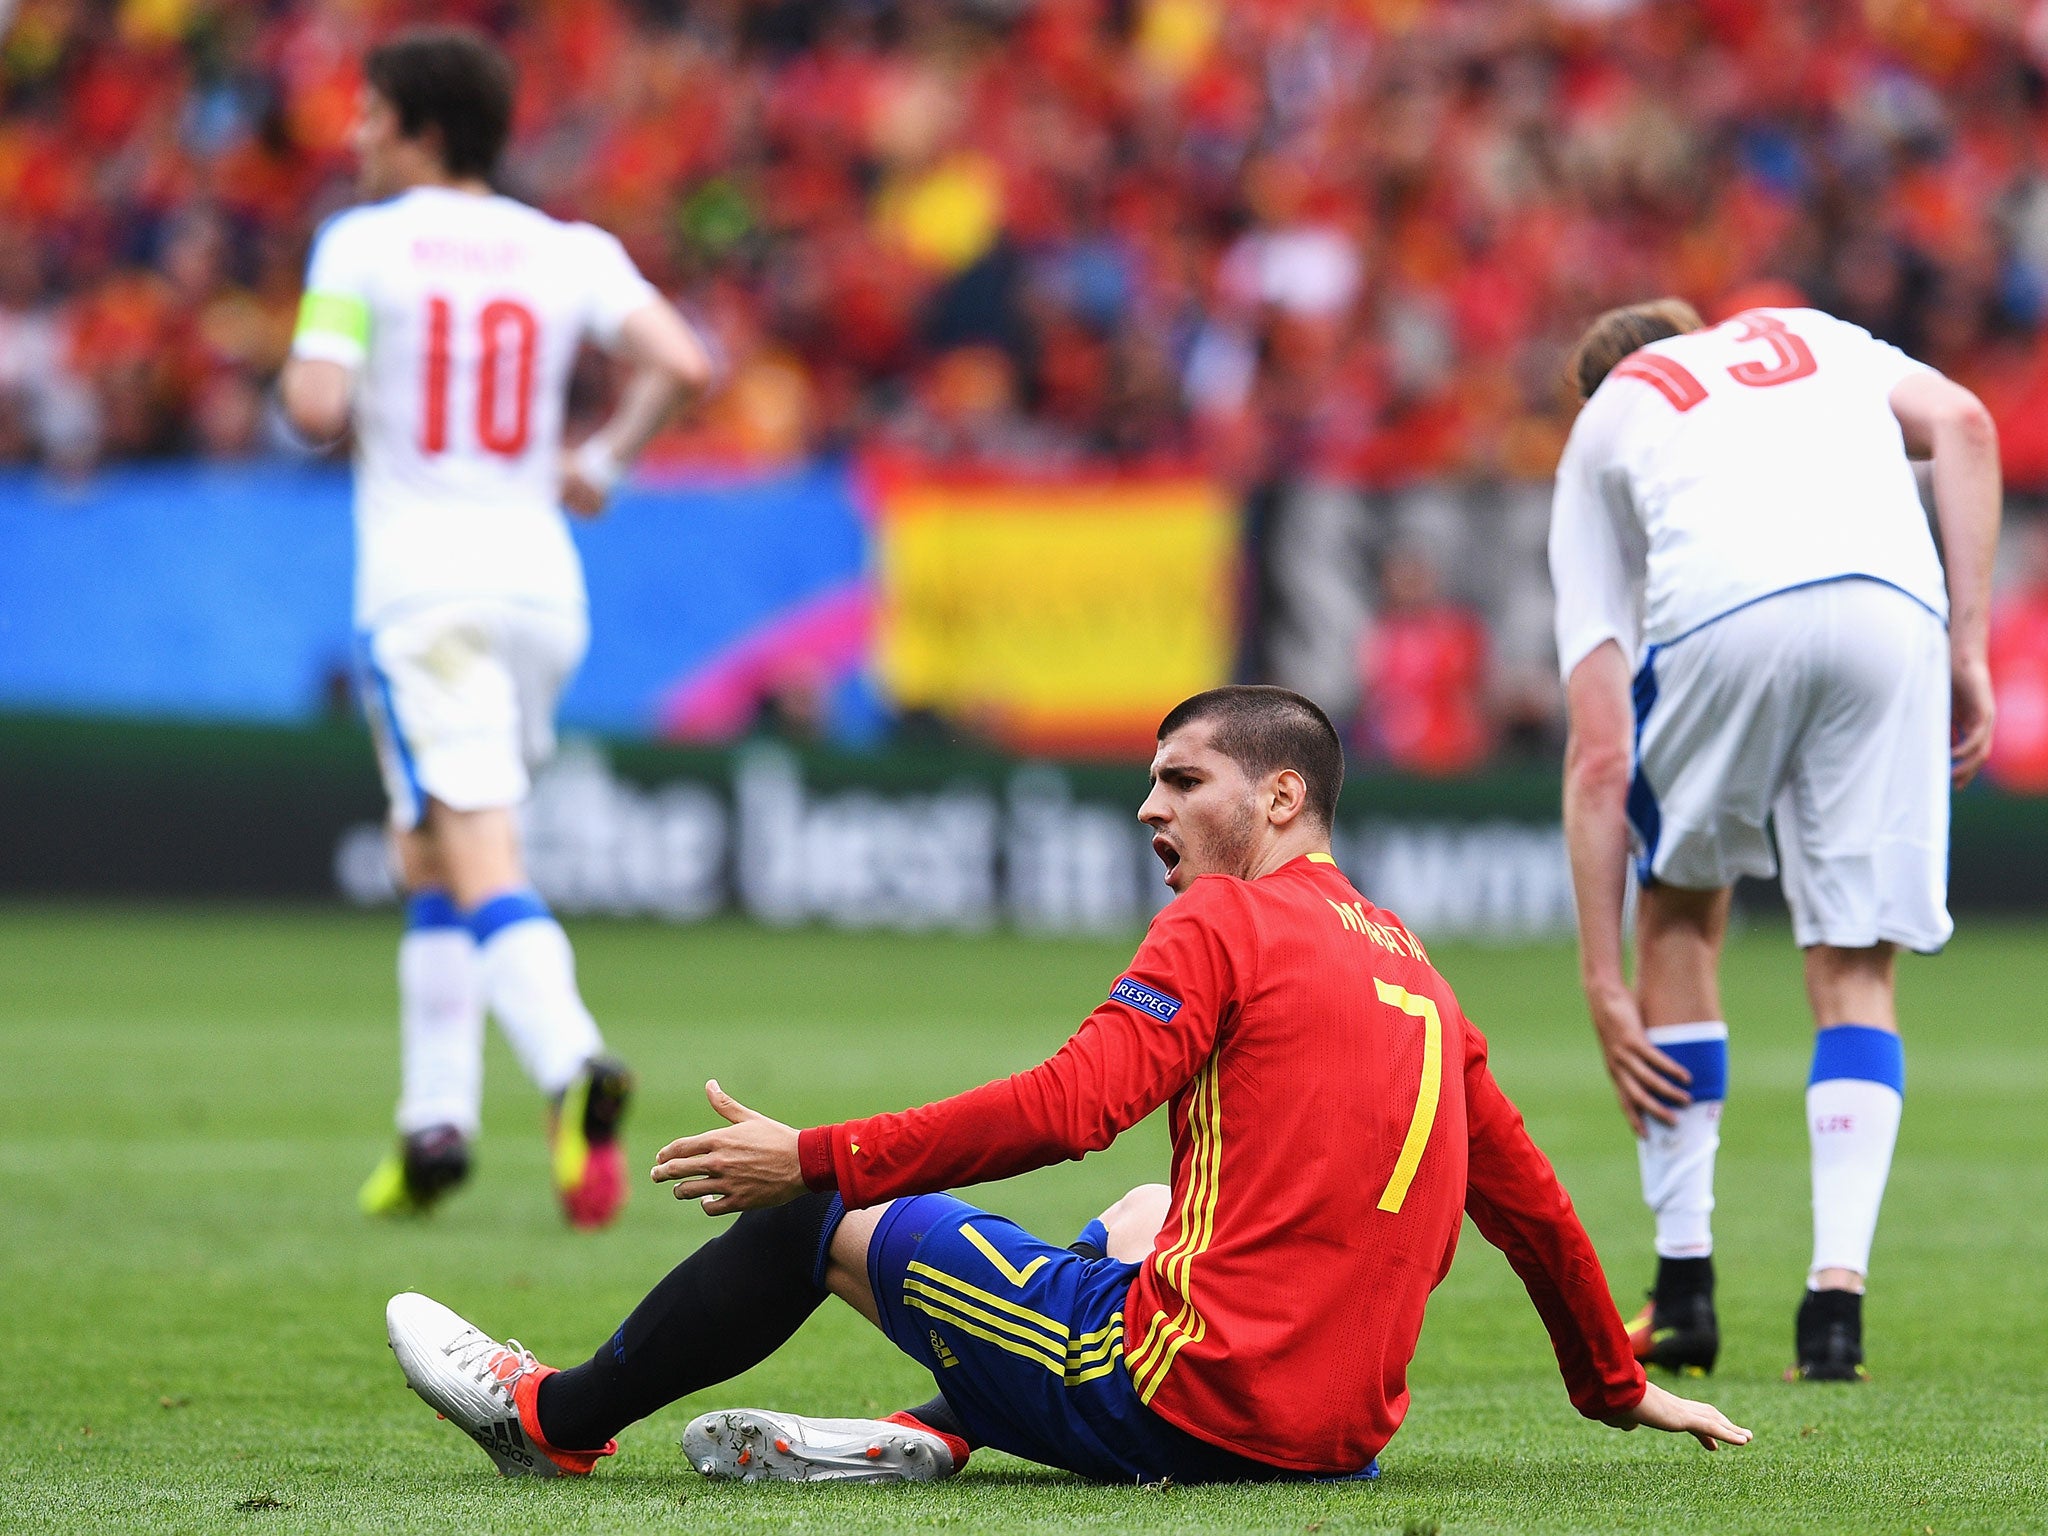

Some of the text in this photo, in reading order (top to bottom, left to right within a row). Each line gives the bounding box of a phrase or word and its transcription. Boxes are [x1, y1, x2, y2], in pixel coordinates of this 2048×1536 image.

[423, 297, 538, 455] 10
[1611, 314, 1818, 412] 13
[1116, 983, 1177, 1017] RESPECT
[1373, 976, 1442, 1214] 7
[959, 1222, 1050, 1288] 7
[930, 1329, 943, 1362] adid
[472, 1431, 534, 1468] adidas
